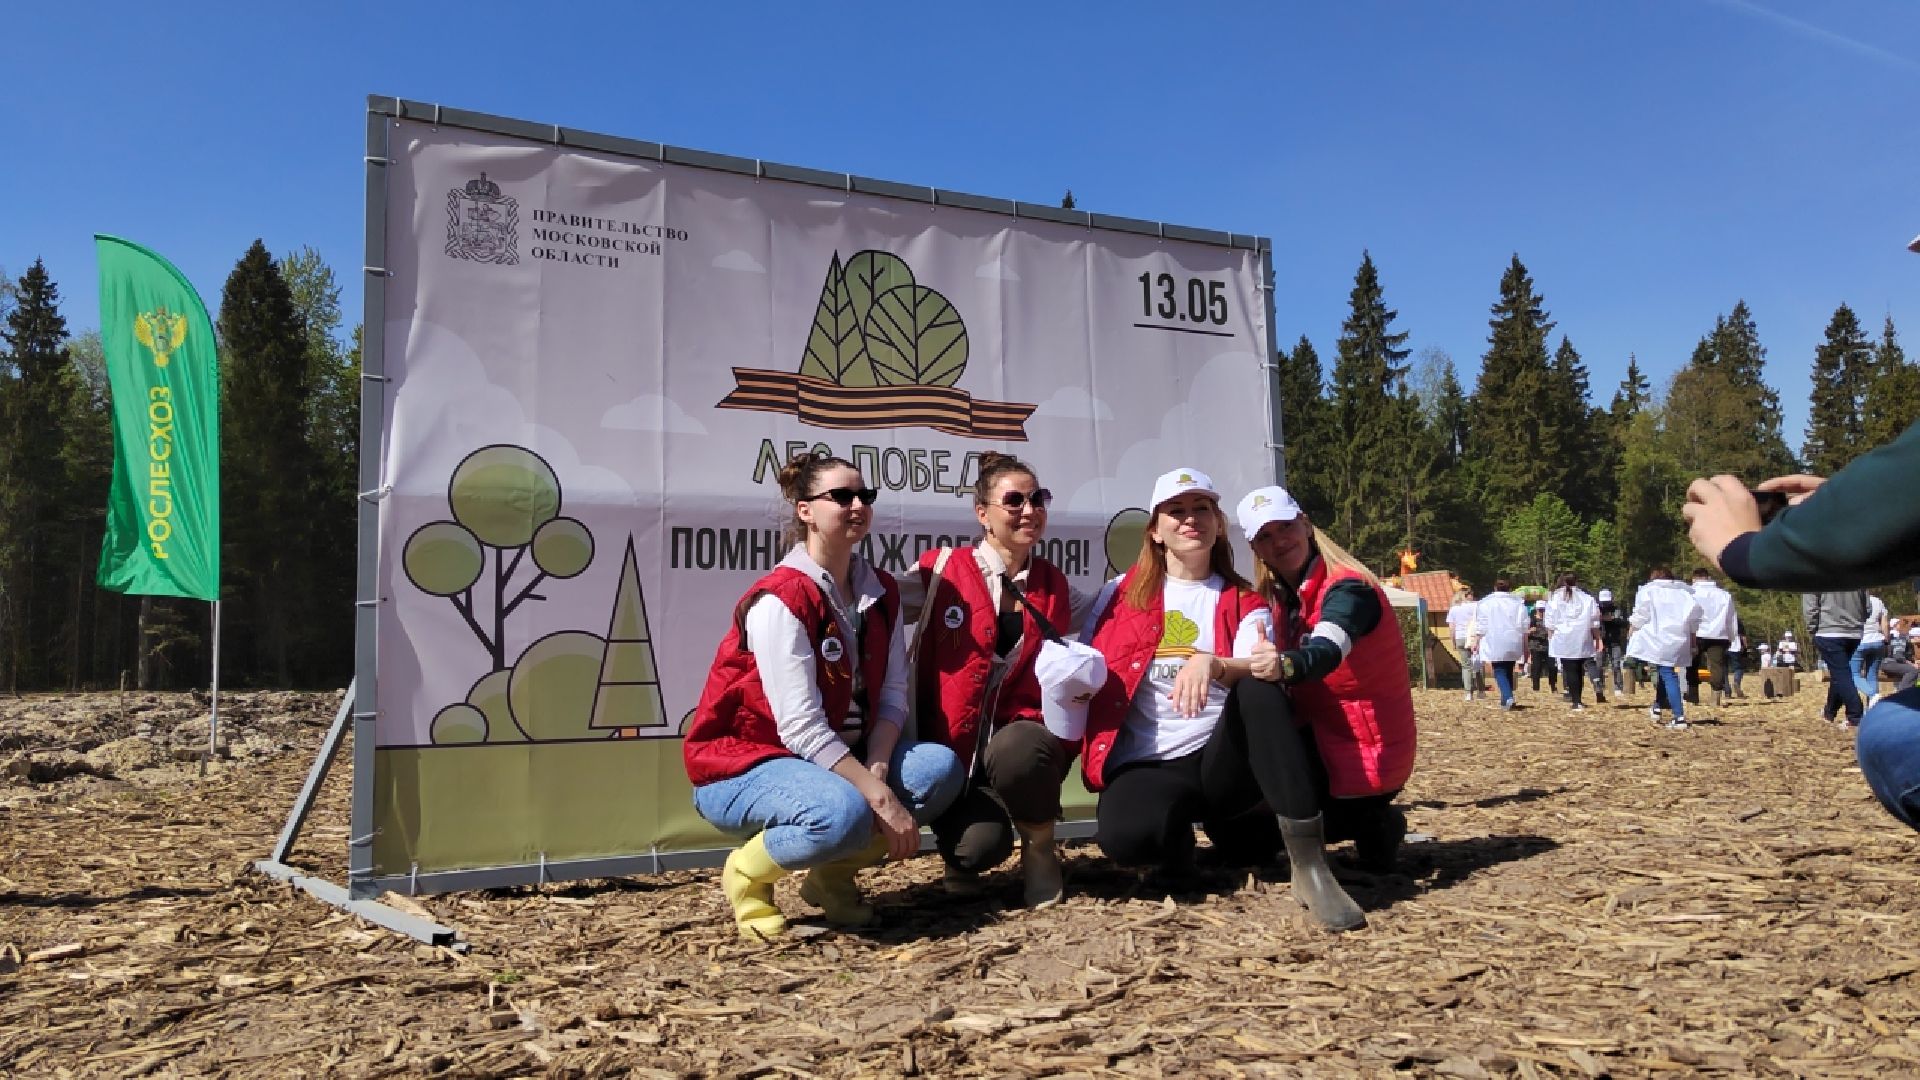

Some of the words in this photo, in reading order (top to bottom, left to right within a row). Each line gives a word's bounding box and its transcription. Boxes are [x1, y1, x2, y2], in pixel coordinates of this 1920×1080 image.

[532, 228, 661, 256] МОСКОВСКОЙ
[533, 209, 689, 242] ПРАВИТЕЛЬСТВО
[531, 246, 619, 268] ОБЛАСТИ
[1138, 271, 1228, 325] 13.05
[148, 386, 173, 559] РОСЛЕСХОЗ
[852, 445, 1018, 498] ПОБЕД
